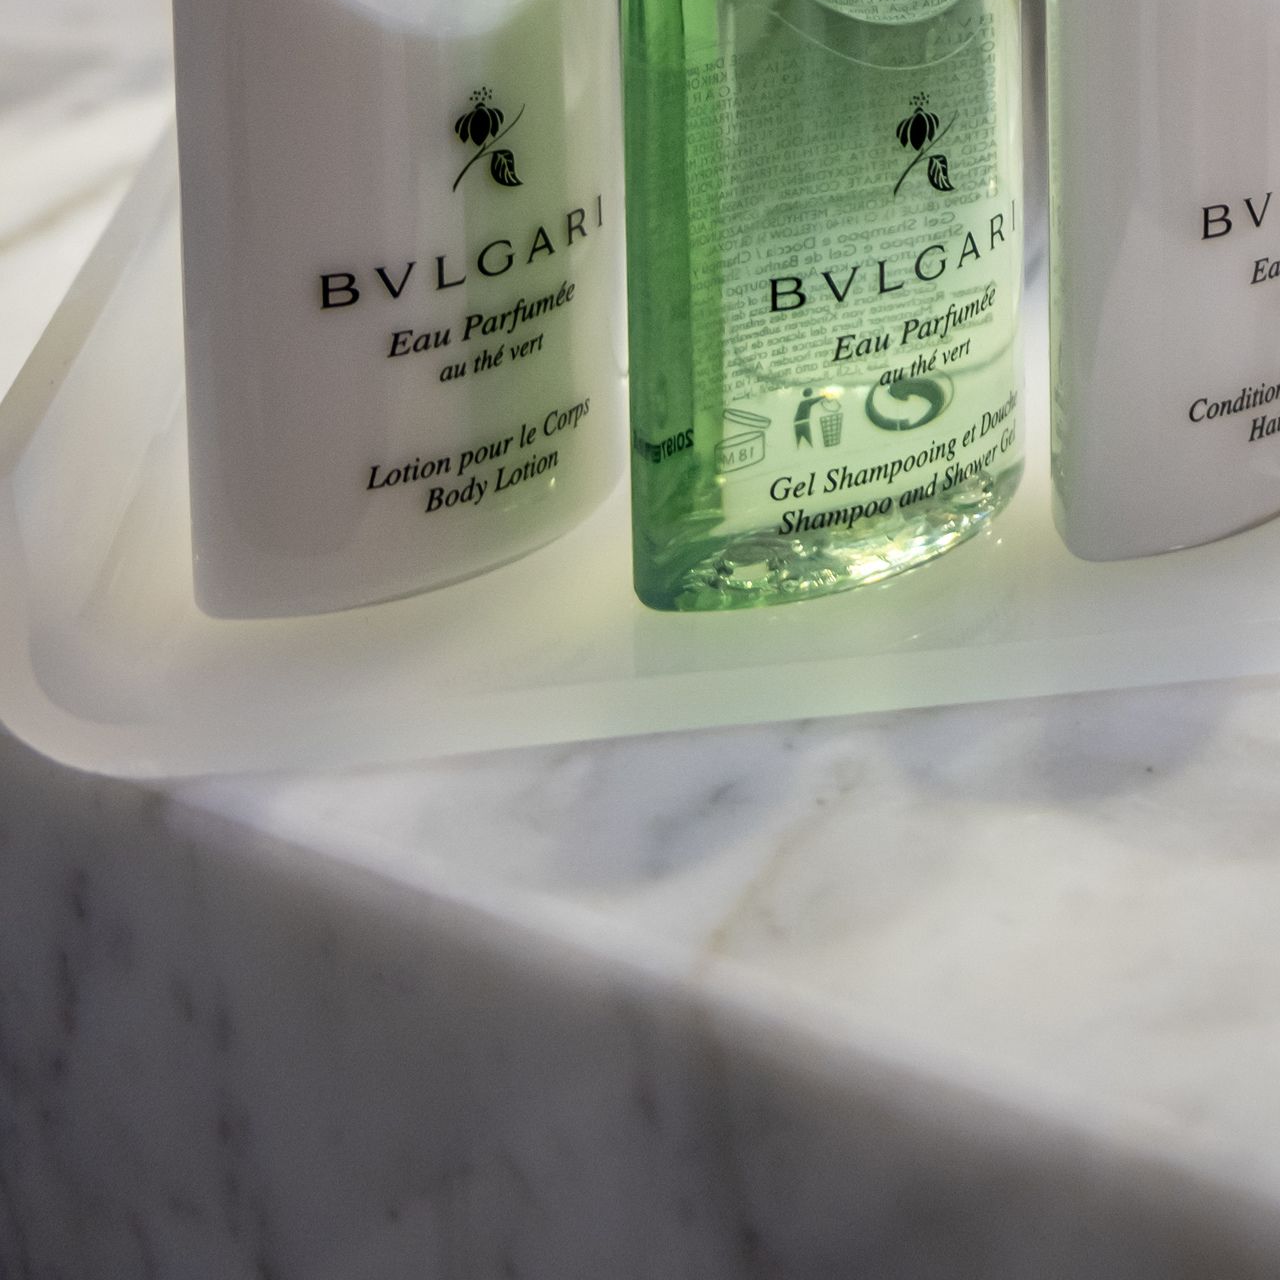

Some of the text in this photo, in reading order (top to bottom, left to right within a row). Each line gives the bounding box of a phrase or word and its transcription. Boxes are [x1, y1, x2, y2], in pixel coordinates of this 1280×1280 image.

[320, 194, 603, 309] BVLGARI
[769, 200, 1016, 313] BVLGARI
[387, 280, 576, 358] Eau Parfumée
[439, 332, 544, 382] au thé vert
[831, 334, 892, 363] Eau
[900, 287, 997, 346] Parfumée
[879, 367, 907, 387] au
[909, 350, 938, 378] thé
[942, 338, 971, 363] vert
[366, 396, 592, 490] Lotion pour le Corps
[425, 447, 560, 513] Body Lotion
[769, 471, 817, 502] Gel
[822, 437, 958, 494] Shampooing
[961, 423, 978, 449] et
[778, 417, 1017, 537] Shampoo and Shower Gel
